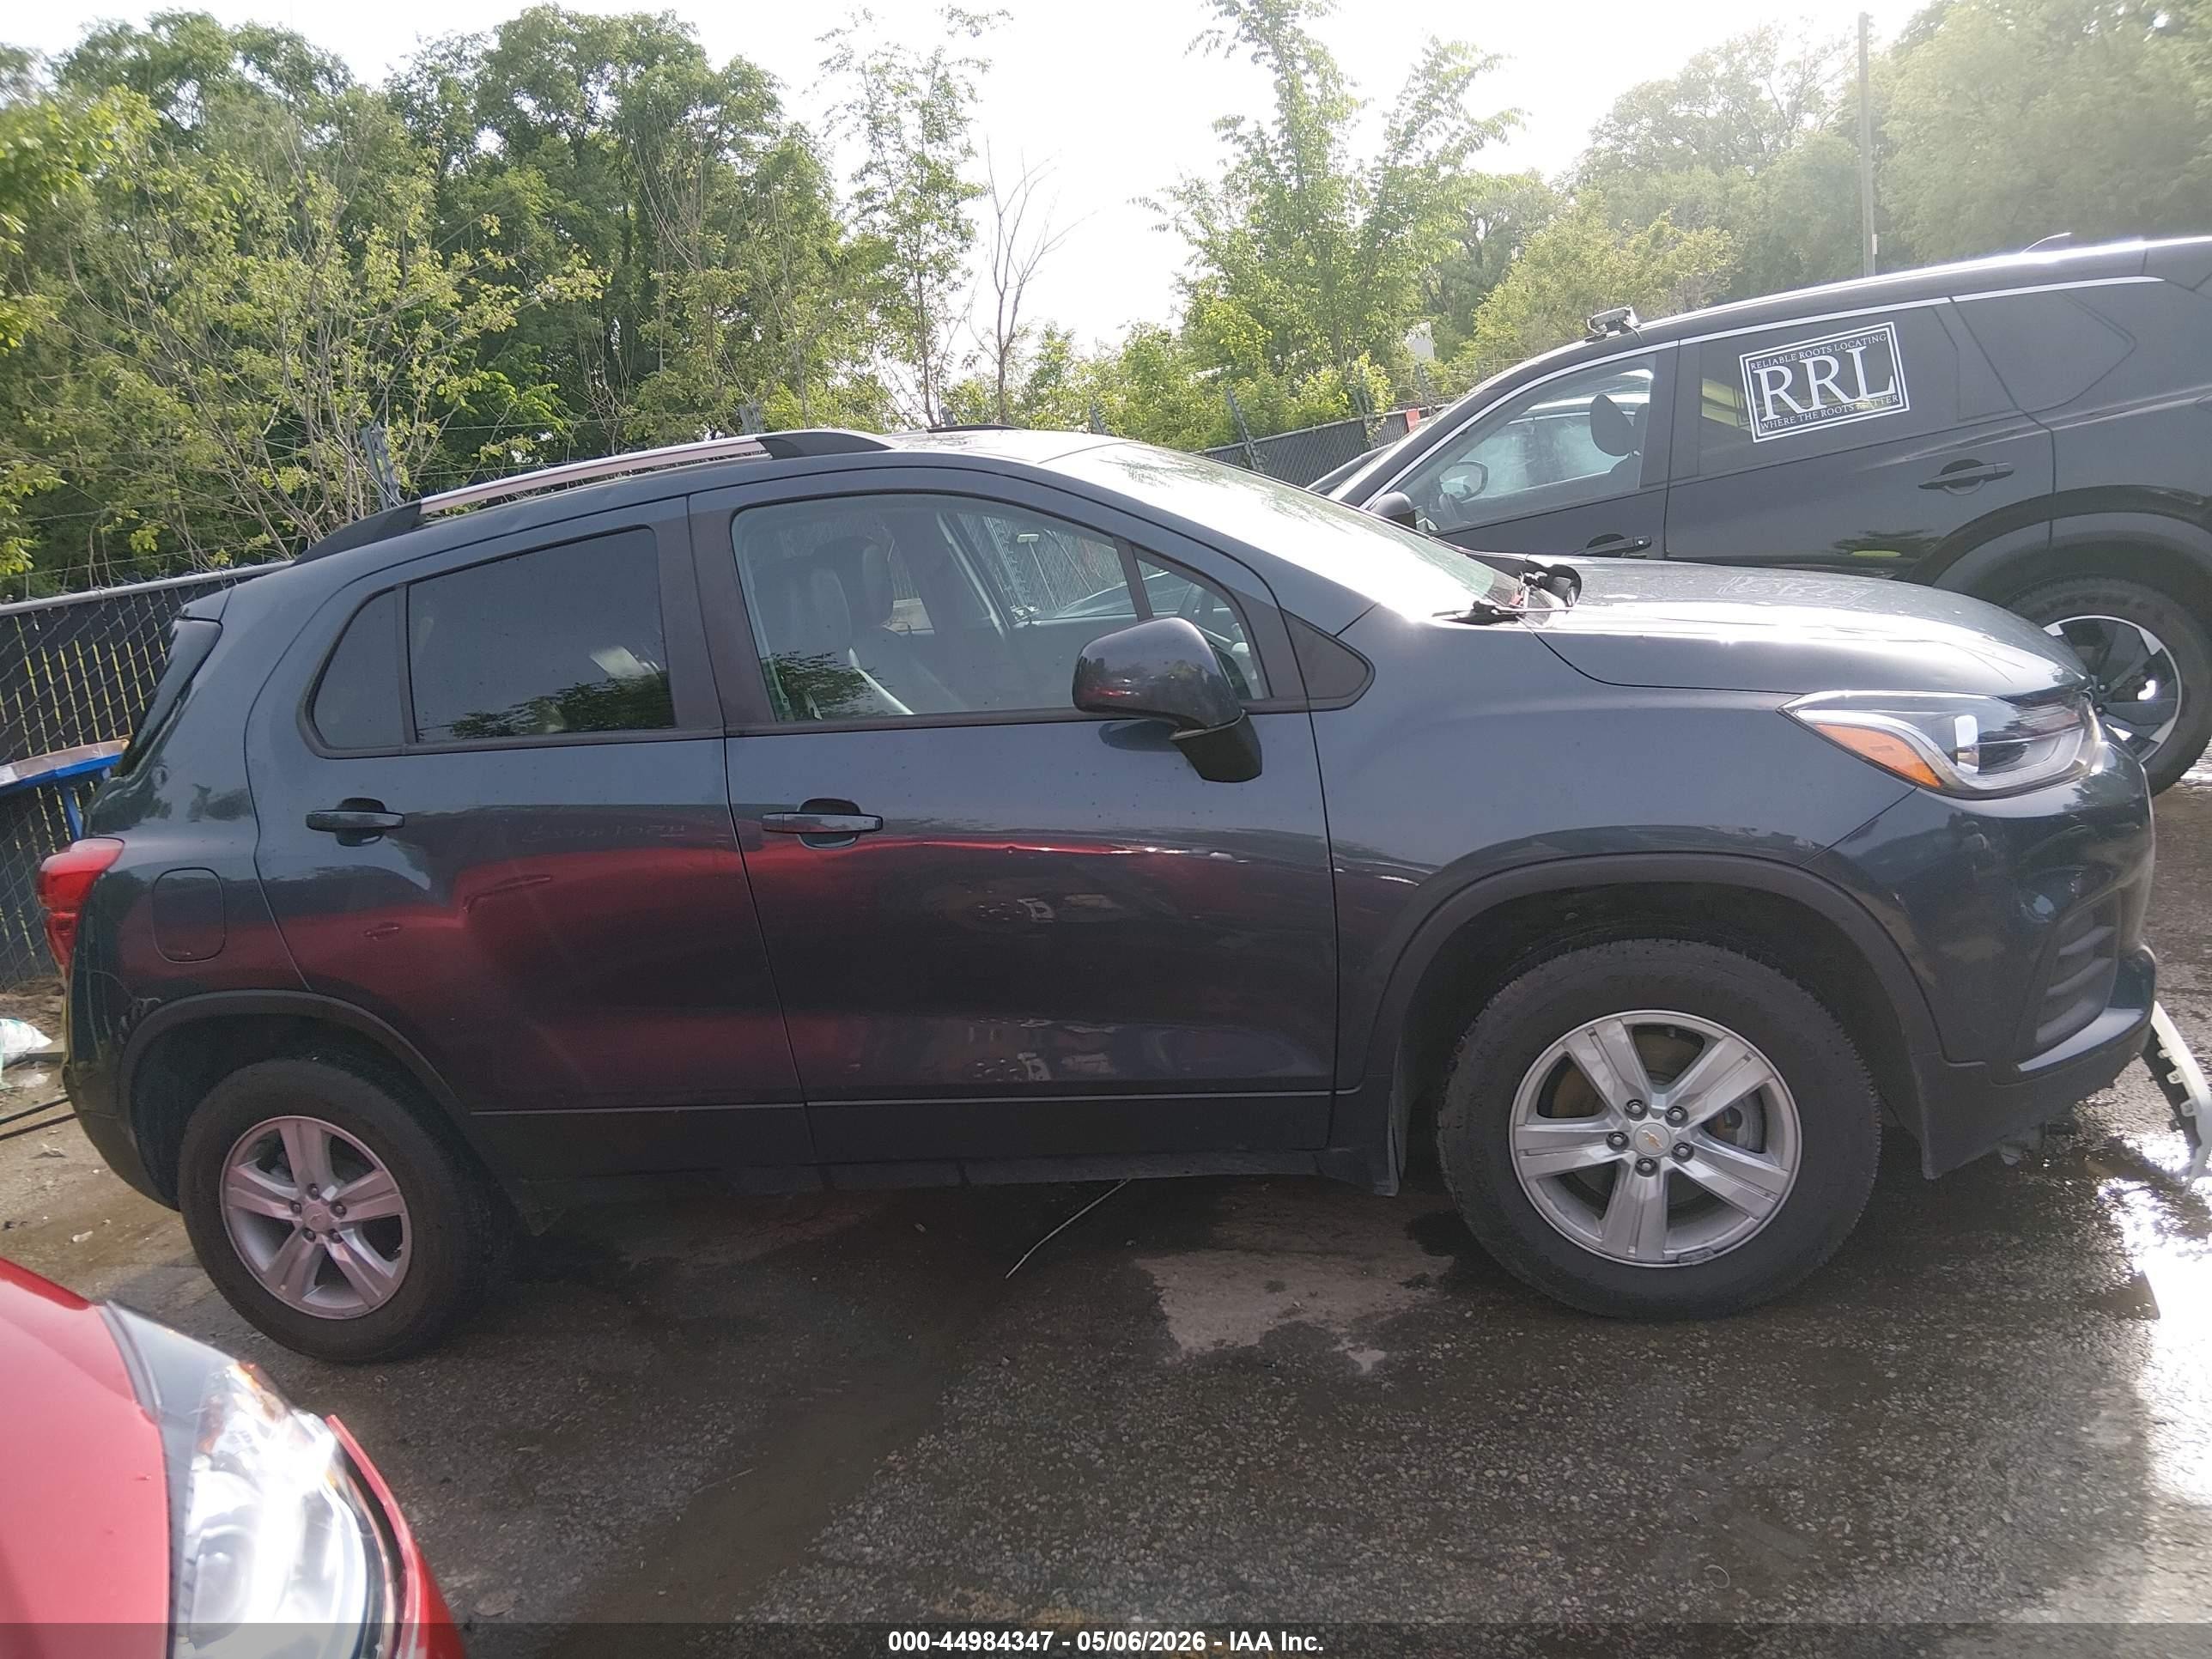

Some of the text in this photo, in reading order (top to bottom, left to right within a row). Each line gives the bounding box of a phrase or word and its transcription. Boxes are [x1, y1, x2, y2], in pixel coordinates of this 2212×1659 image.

[1751, 333, 1887, 370] RELIABLE ROOTS LOCATING
[1753, 345, 1896, 422] RRL
[1759, 416, 1796, 430] WHERE
[1799, 411, 1819, 422] THE
[1820, 404, 1854, 418] ROOTS
